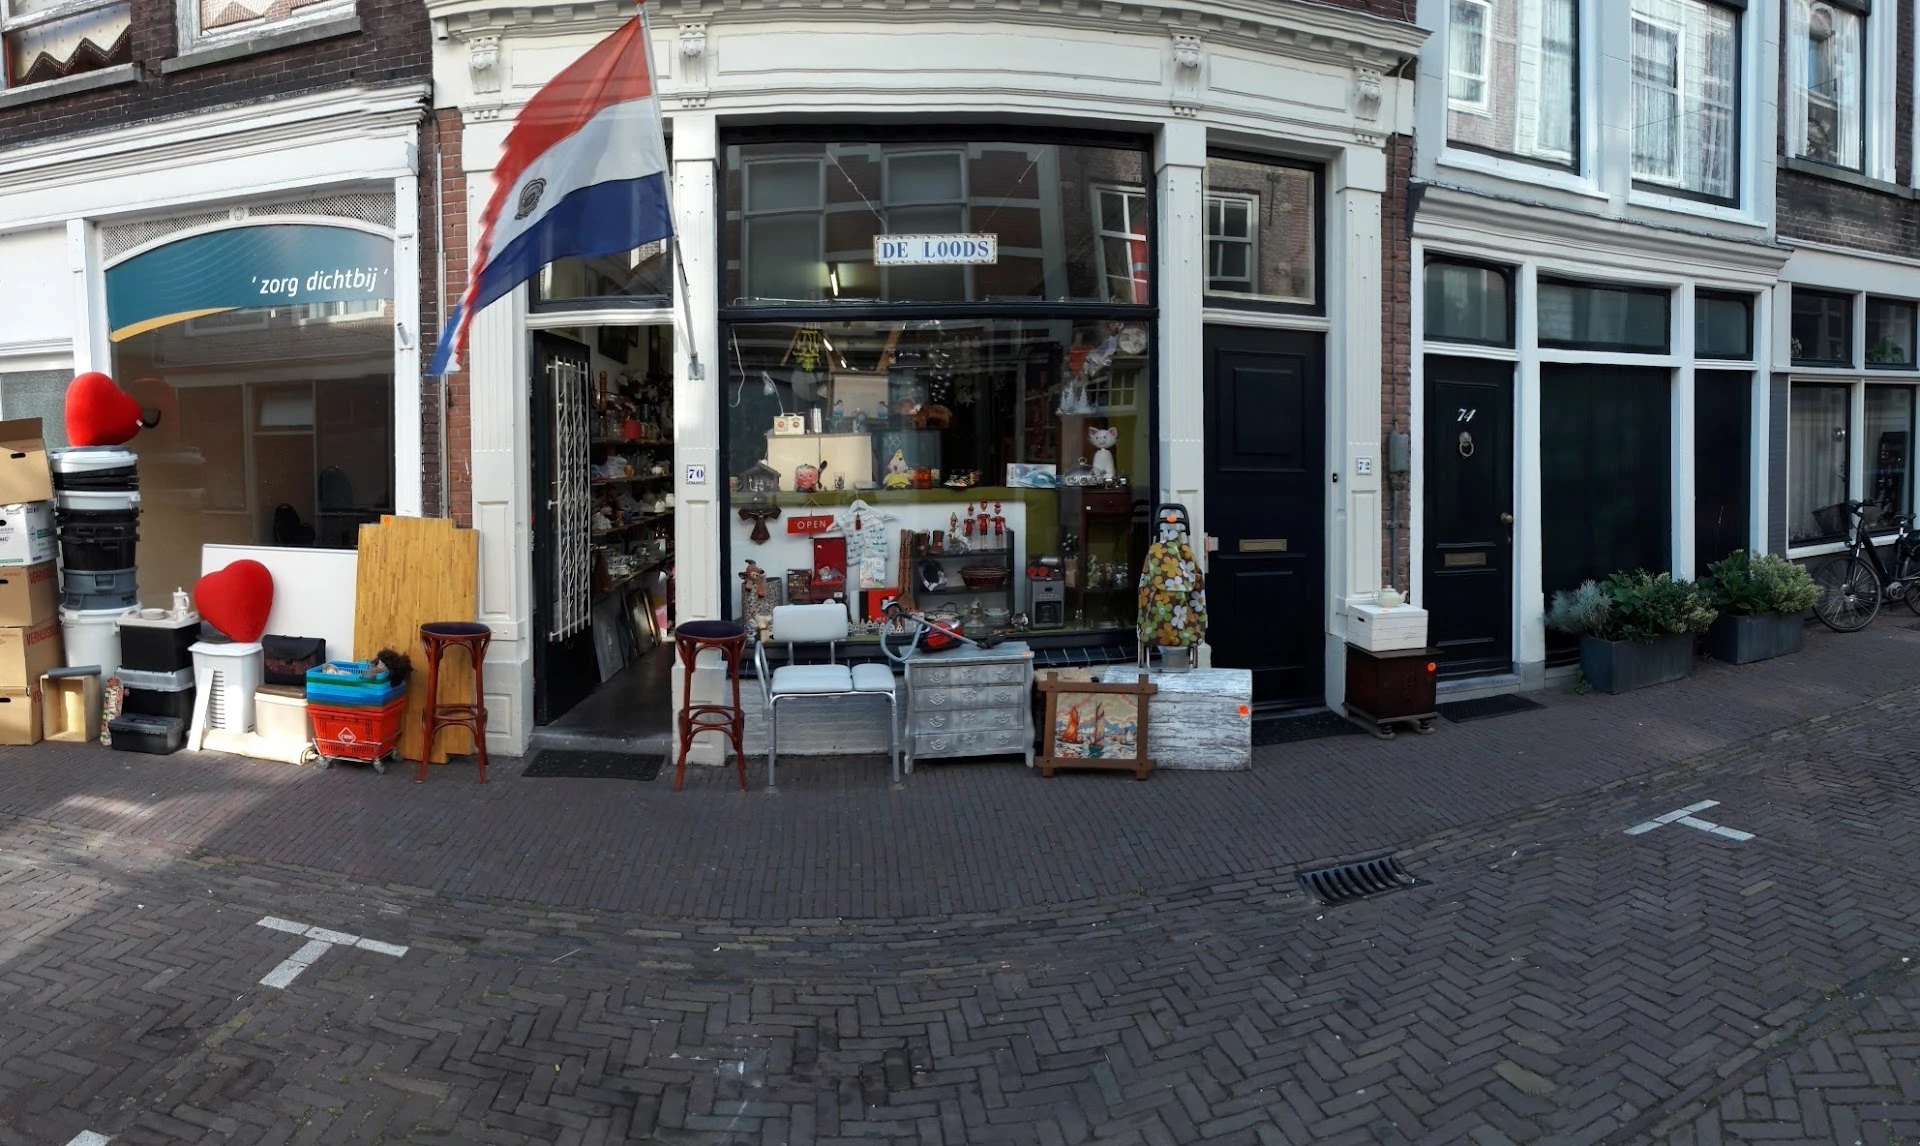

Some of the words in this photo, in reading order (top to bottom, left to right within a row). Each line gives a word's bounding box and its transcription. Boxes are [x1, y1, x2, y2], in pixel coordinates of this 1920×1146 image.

[882, 241, 908, 259] DE
[923, 240, 990, 259] LOODS
[1456, 408, 1477, 422] 74
[1358, 461, 1371, 471] 72
[688, 468, 705, 479] 70
[796, 520, 826, 530] OPEN
